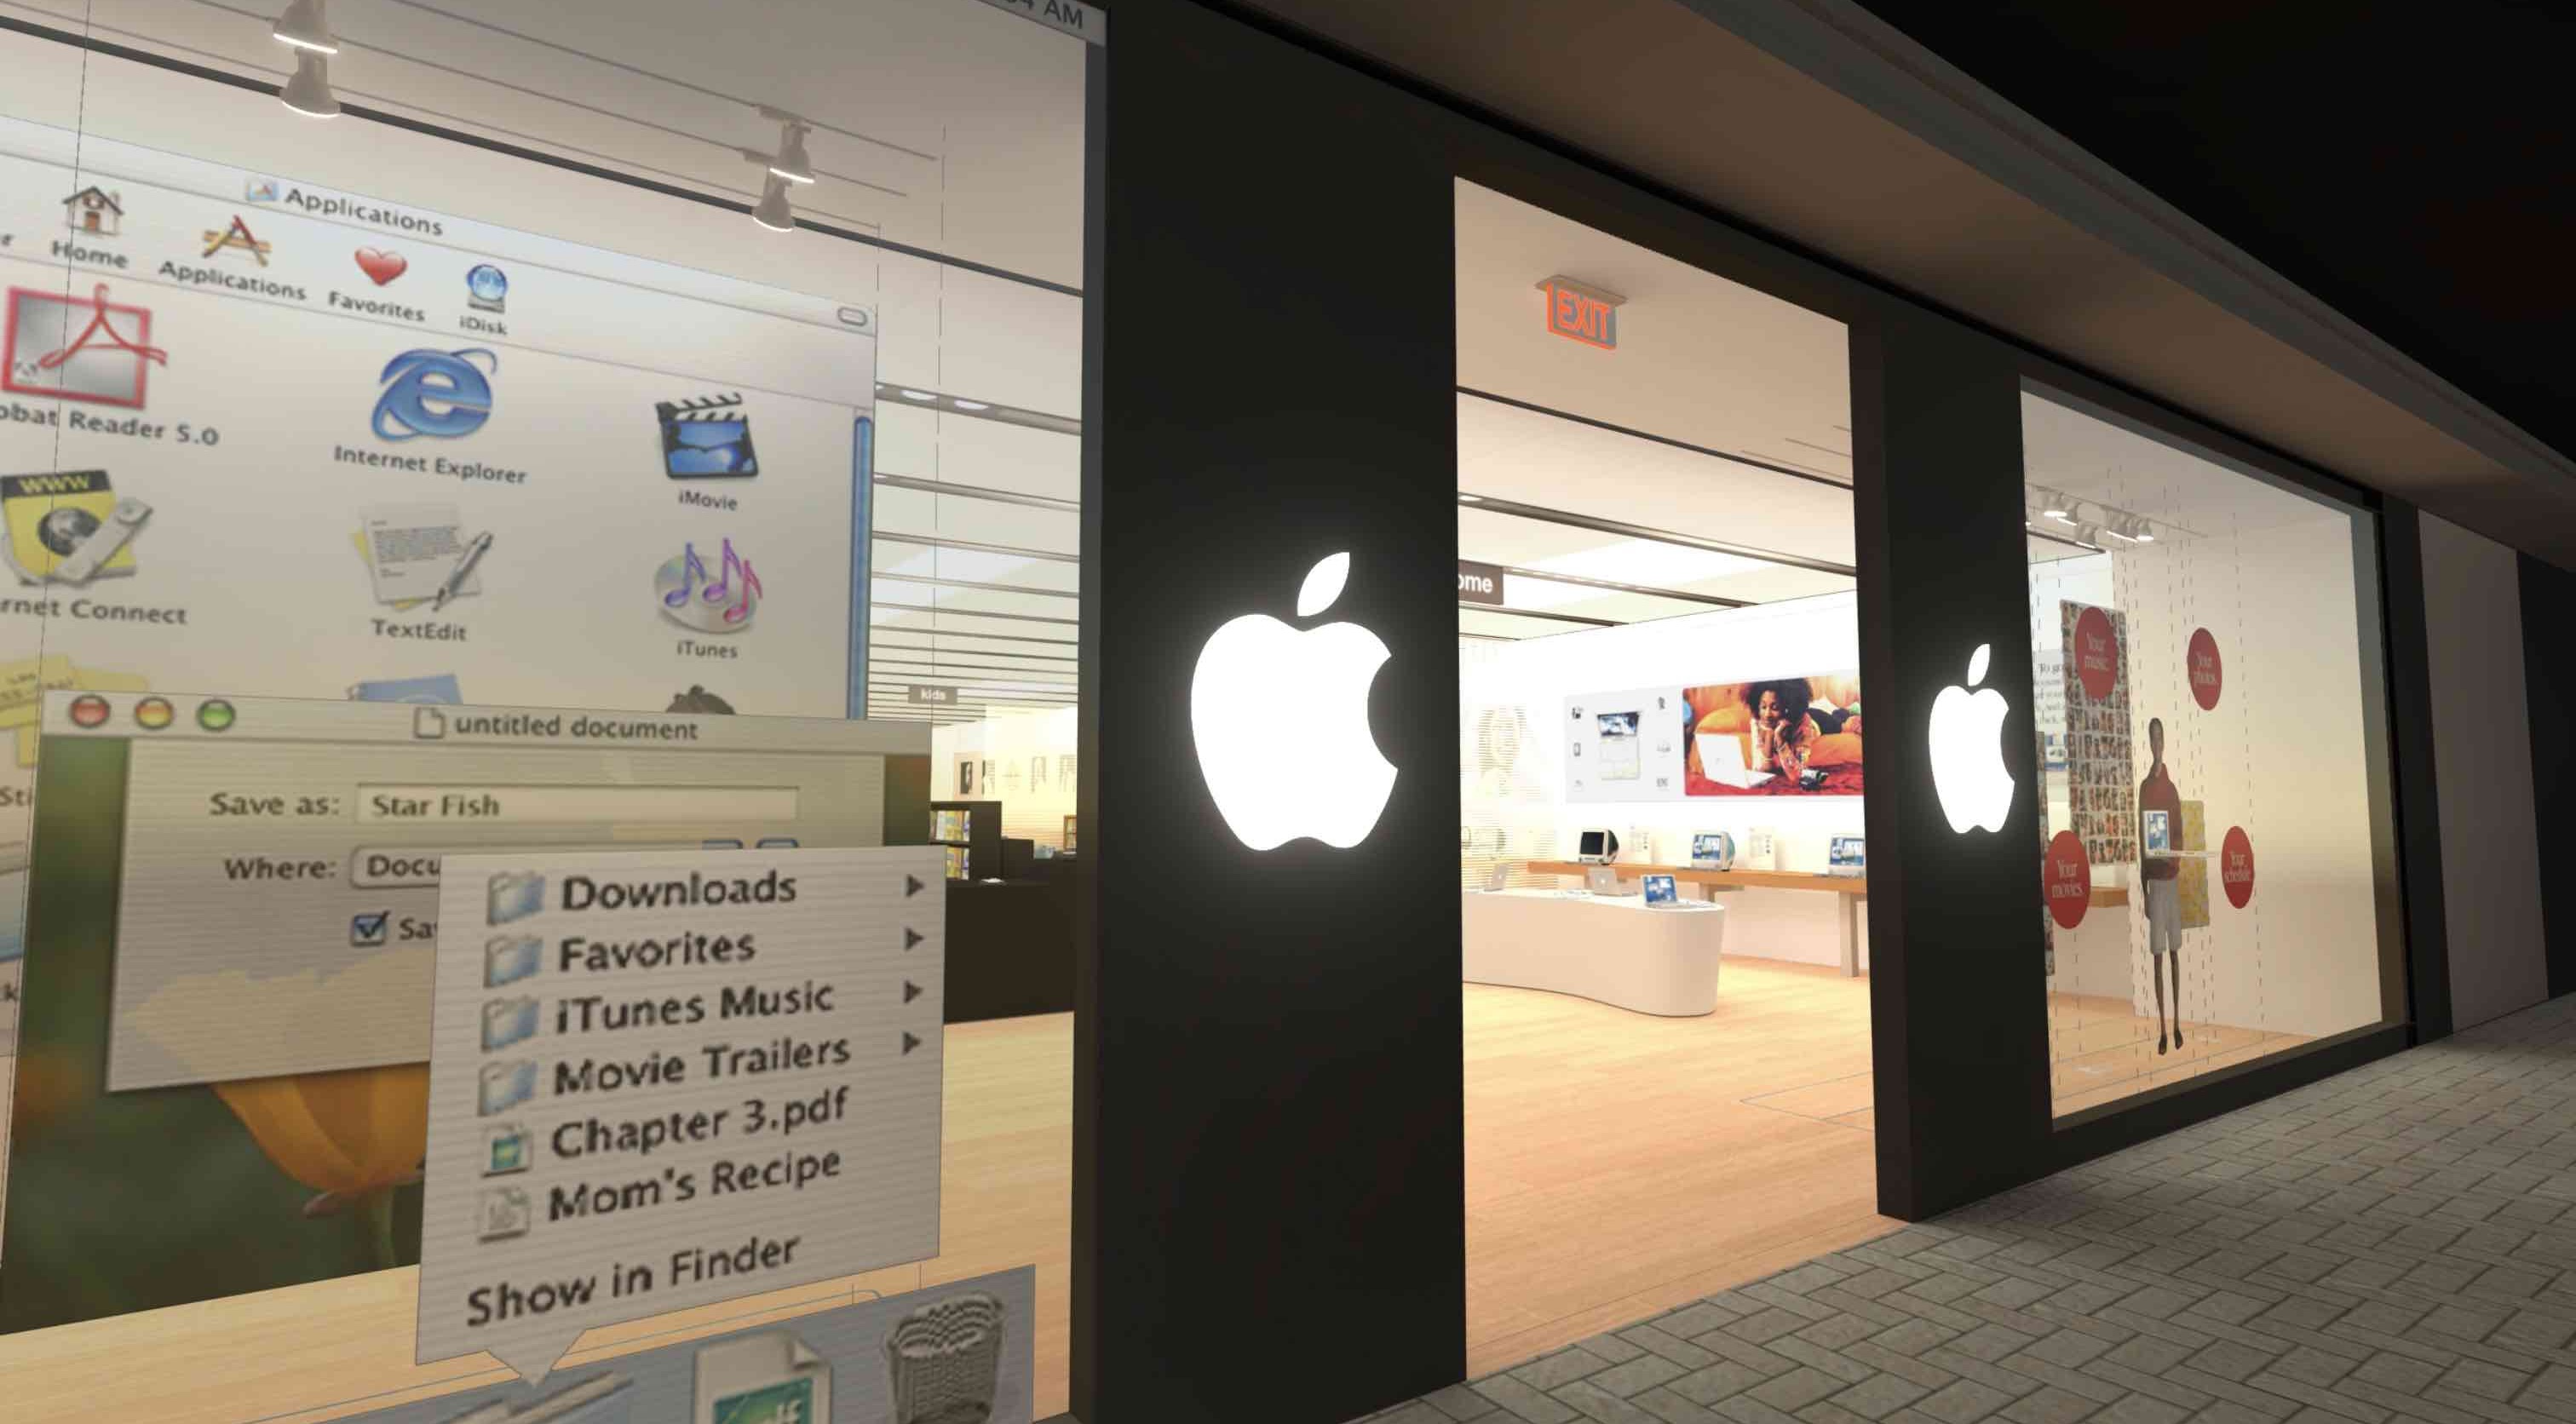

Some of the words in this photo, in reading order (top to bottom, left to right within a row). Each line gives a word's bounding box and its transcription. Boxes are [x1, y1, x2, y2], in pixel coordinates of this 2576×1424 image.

[1043, 0, 1083, 29] AM
[285, 186, 443, 237] Applications
[52, 239, 129, 269] Home
[158, 259, 307, 301] Applications
[328, 290, 425, 323] Favorites
[1557, 288, 1610, 340] EXIT
[459, 314, 508, 336] iDisk
[69, 410, 166, 439] Reader
[175, 424, 220, 446] 5.0
[334, 445, 427, 474] Internet
[434, 456, 526, 486] Explorer
[19, 474, 89, 494] WWW
[678, 489, 738, 511] iMovie
[70, 598, 188, 625] Connect
[371, 617, 467, 642] TextEdit
[677, 640, 738, 659] iTunes
[920, 687, 947, 701] kids
[456, 710, 561, 738] untitled
[572, 714, 699, 741] document
[210, 792, 285, 817] Save
[296, 795, 341, 816] as:
[371, 793, 433, 817] Star
[440, 793, 500, 817] Fish
[223, 856, 337, 881] Where:
[561, 869, 797, 912] Downloads
[558, 930, 756, 973] Favorites
[555, 991, 705, 1035] iTunes
[719, 979, 835, 1021] Music
[554, 1052, 686, 1095] Movie
[701, 1034, 851, 1079] Trailers
[550, 1107, 728, 1160] Chapter
[742, 1085, 851, 1135] 3.pdf
[548, 1167, 697, 1223] Mom's
[710, 1148, 842, 1196] Recipe
[467, 1276, 598, 1328] Show
[612, 1262, 653, 1299] in
[670, 1233, 801, 1287] Finder
